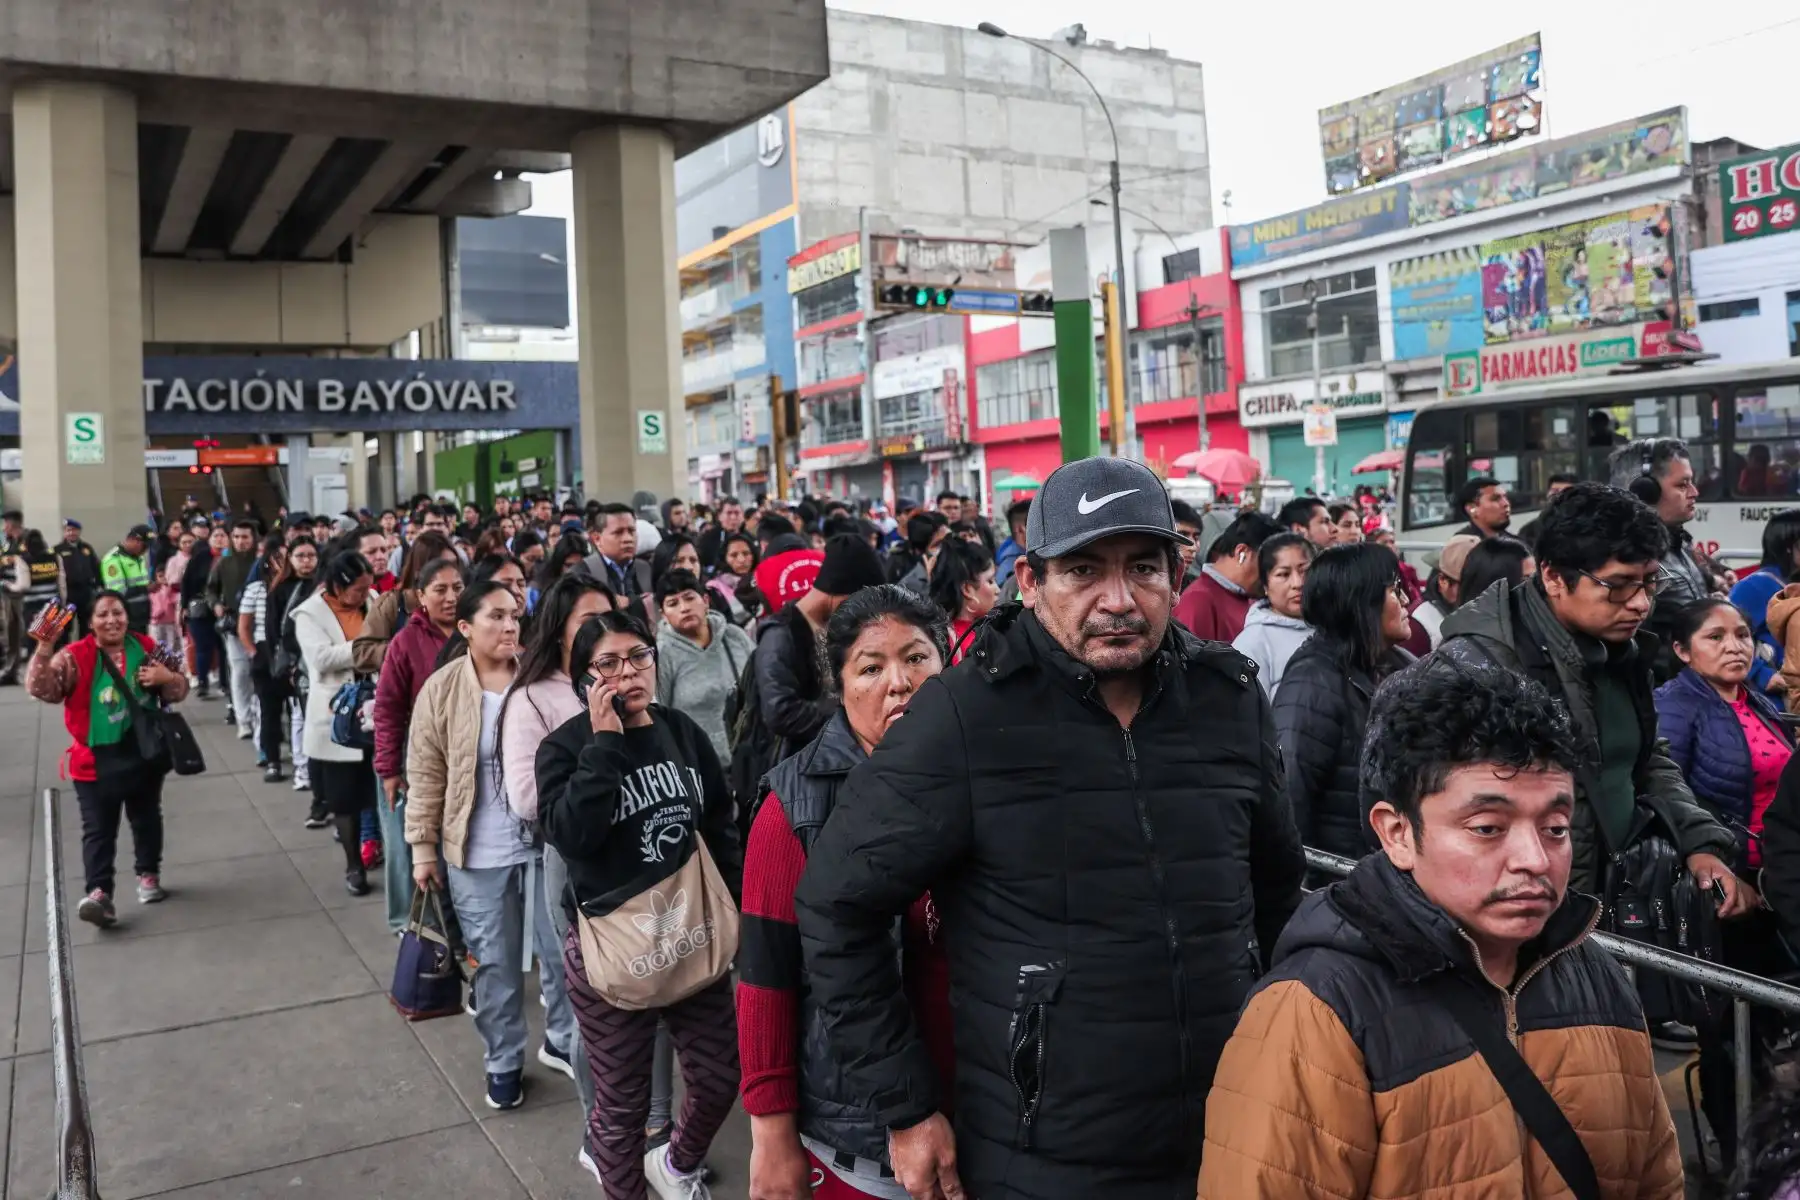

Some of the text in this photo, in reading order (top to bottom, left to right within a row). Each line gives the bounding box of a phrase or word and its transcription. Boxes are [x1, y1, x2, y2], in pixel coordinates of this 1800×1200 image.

[1734, 201, 1796, 231] 20 25
[1481, 343, 1578, 383] FARMACIAS
[318, 371, 517, 412] BAYÓVAR
[1245, 393, 1298, 417] CHIFA
[74, 417, 96, 443] S
[644, 413, 660, 436] S
